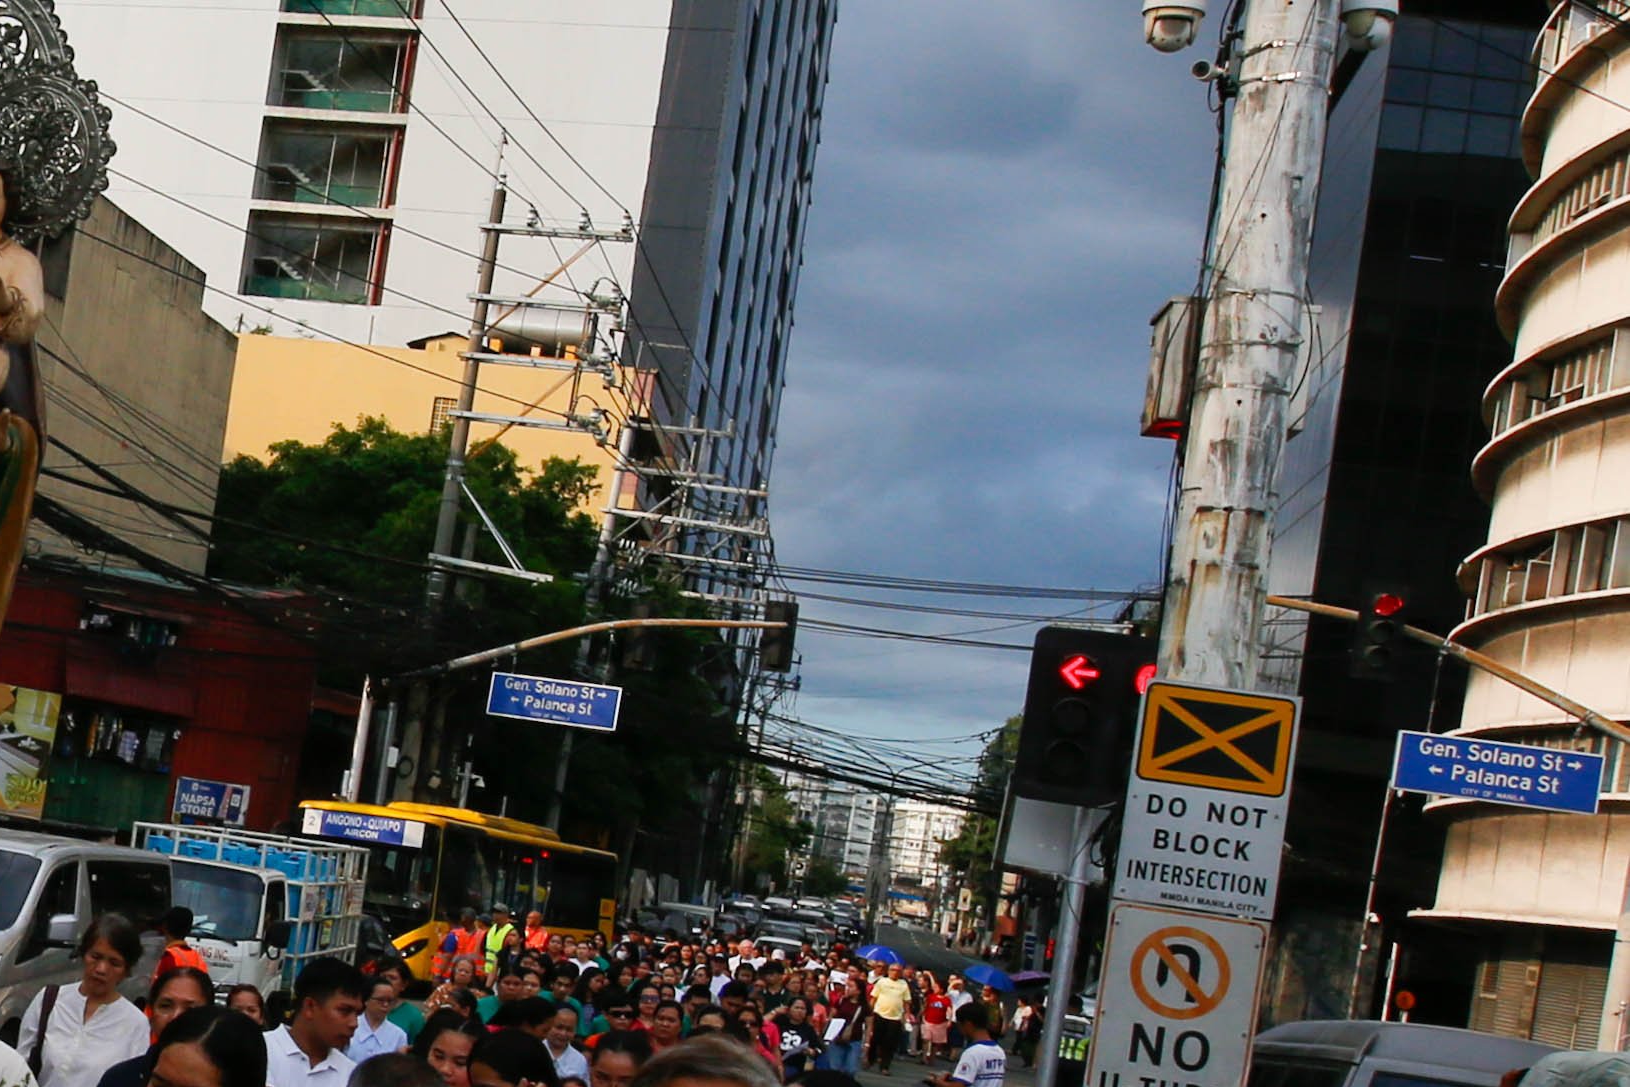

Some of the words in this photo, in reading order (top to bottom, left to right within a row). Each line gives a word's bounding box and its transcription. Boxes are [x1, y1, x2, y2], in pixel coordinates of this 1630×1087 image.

[505, 677, 530, 691] Gen.
[535, 681, 578, 697] Solano
[580, 687, 594, 700] St
[524, 695, 575, 713] Palanca
[578, 702, 592, 715] St
[1419, 738, 1461, 759] Gen.
[1467, 744, 1535, 768] Solano
[1540, 754, 1563, 772] St
[1451, 764, 1532, 791] Palanca
[1537, 775, 1560, 794] St
[1460, 787, 1478, 796] CITY
[1482, 789, 1493, 798] OF
[1496, 791, 1525, 801] MANILA
[180, 803, 213, 817] STORE
[1146, 794, 1187, 818] DO
[1207, 802, 1268, 829] NOT
[307, 815, 316, 827] 2
[325, 814, 362, 828] ANGONO
[367, 818, 401, 833] QUIAPO
[344, 828, 380, 840] AIRCON
[1153, 829, 1251, 861] BLOCK
[1126, 859, 1268, 897] INTERSECTION
[1160, 891, 1189, 905] MMDA
[1197, 896, 1234, 911] MANILA
[1236, 903, 1259, 913] CITY
[780, 1031, 802, 1050] 33
[1128, 1022, 1211, 1072] NO
